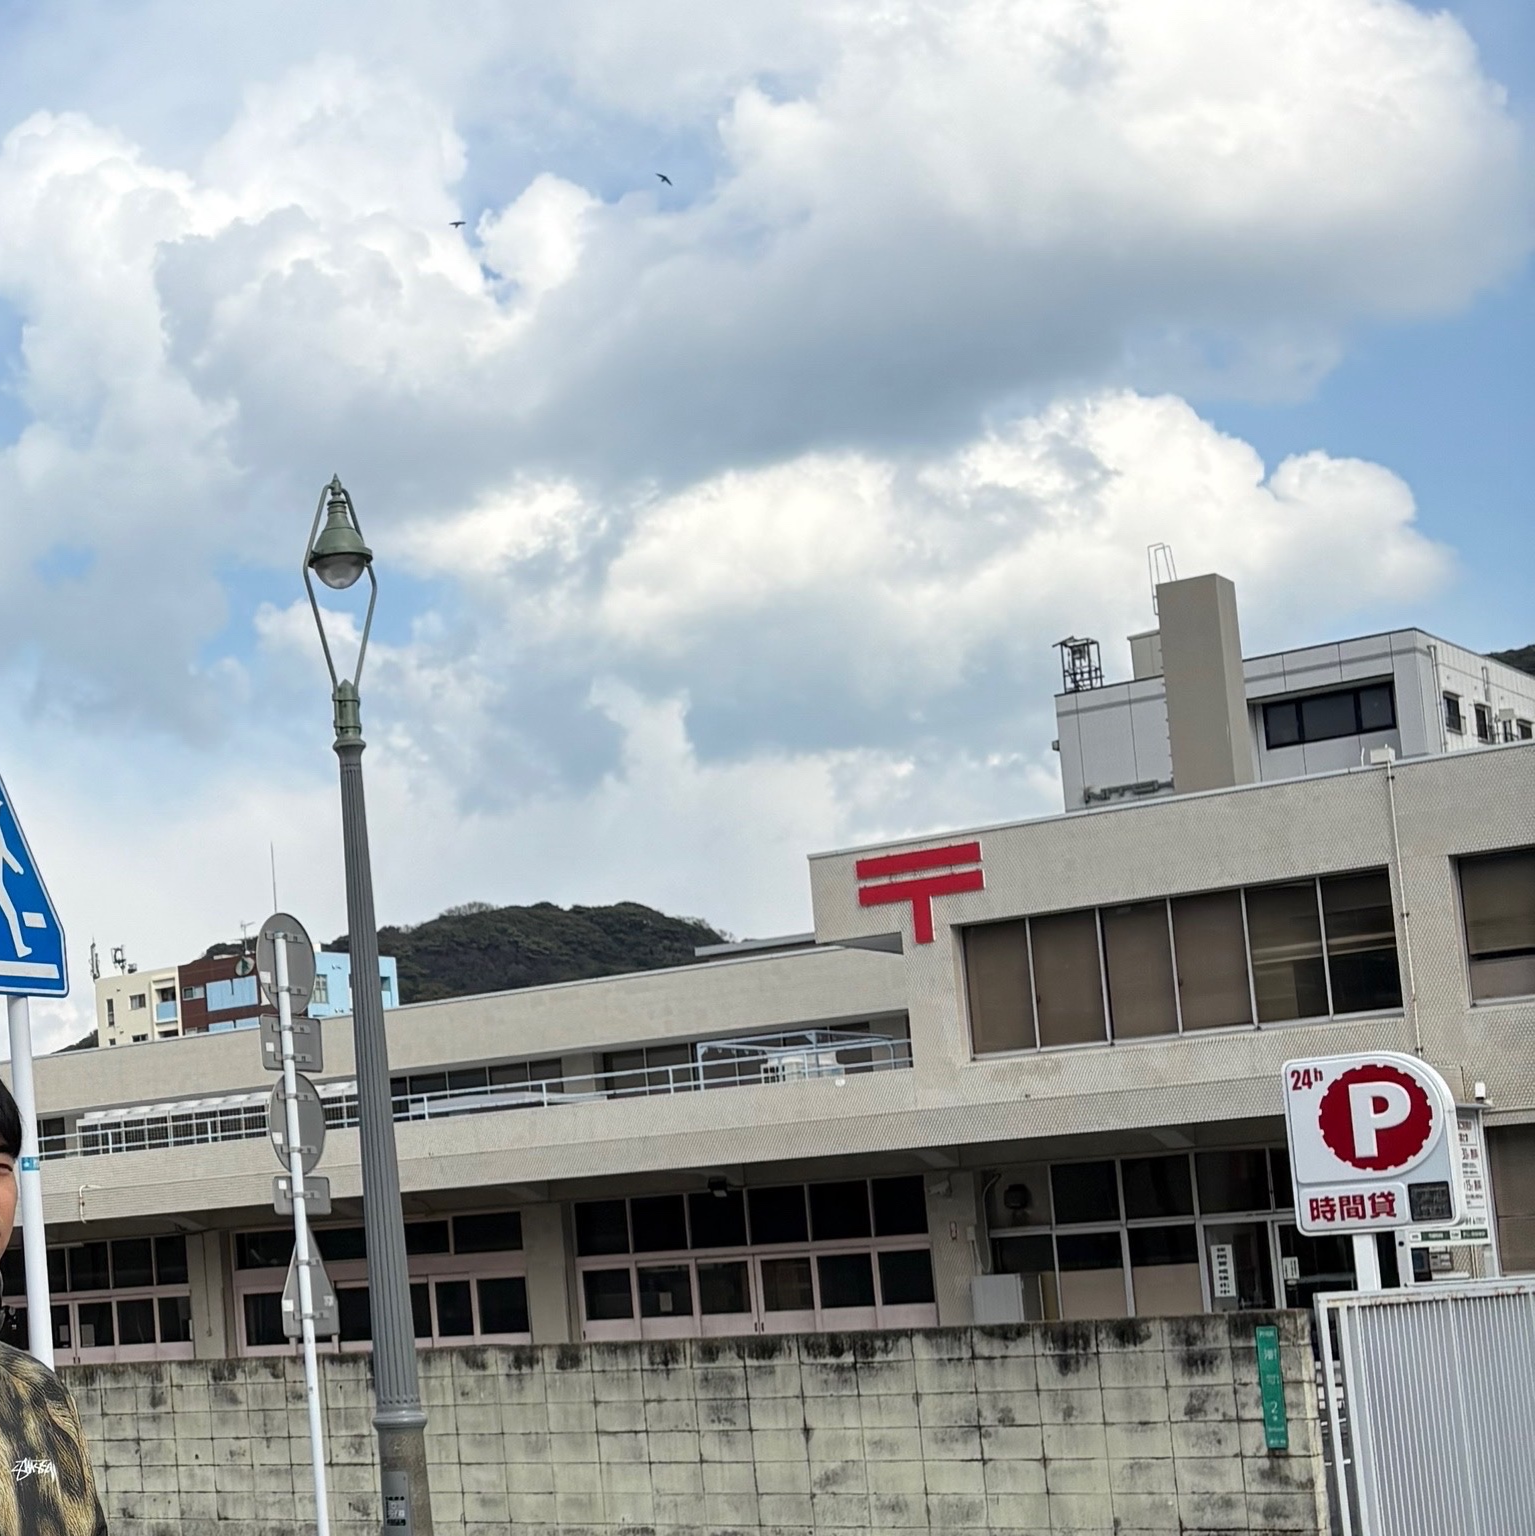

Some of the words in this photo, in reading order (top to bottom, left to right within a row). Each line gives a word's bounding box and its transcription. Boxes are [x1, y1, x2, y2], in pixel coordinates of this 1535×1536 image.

[1348, 1081, 1411, 1158] P
[1309, 1191, 1397, 1222] 時間貸
